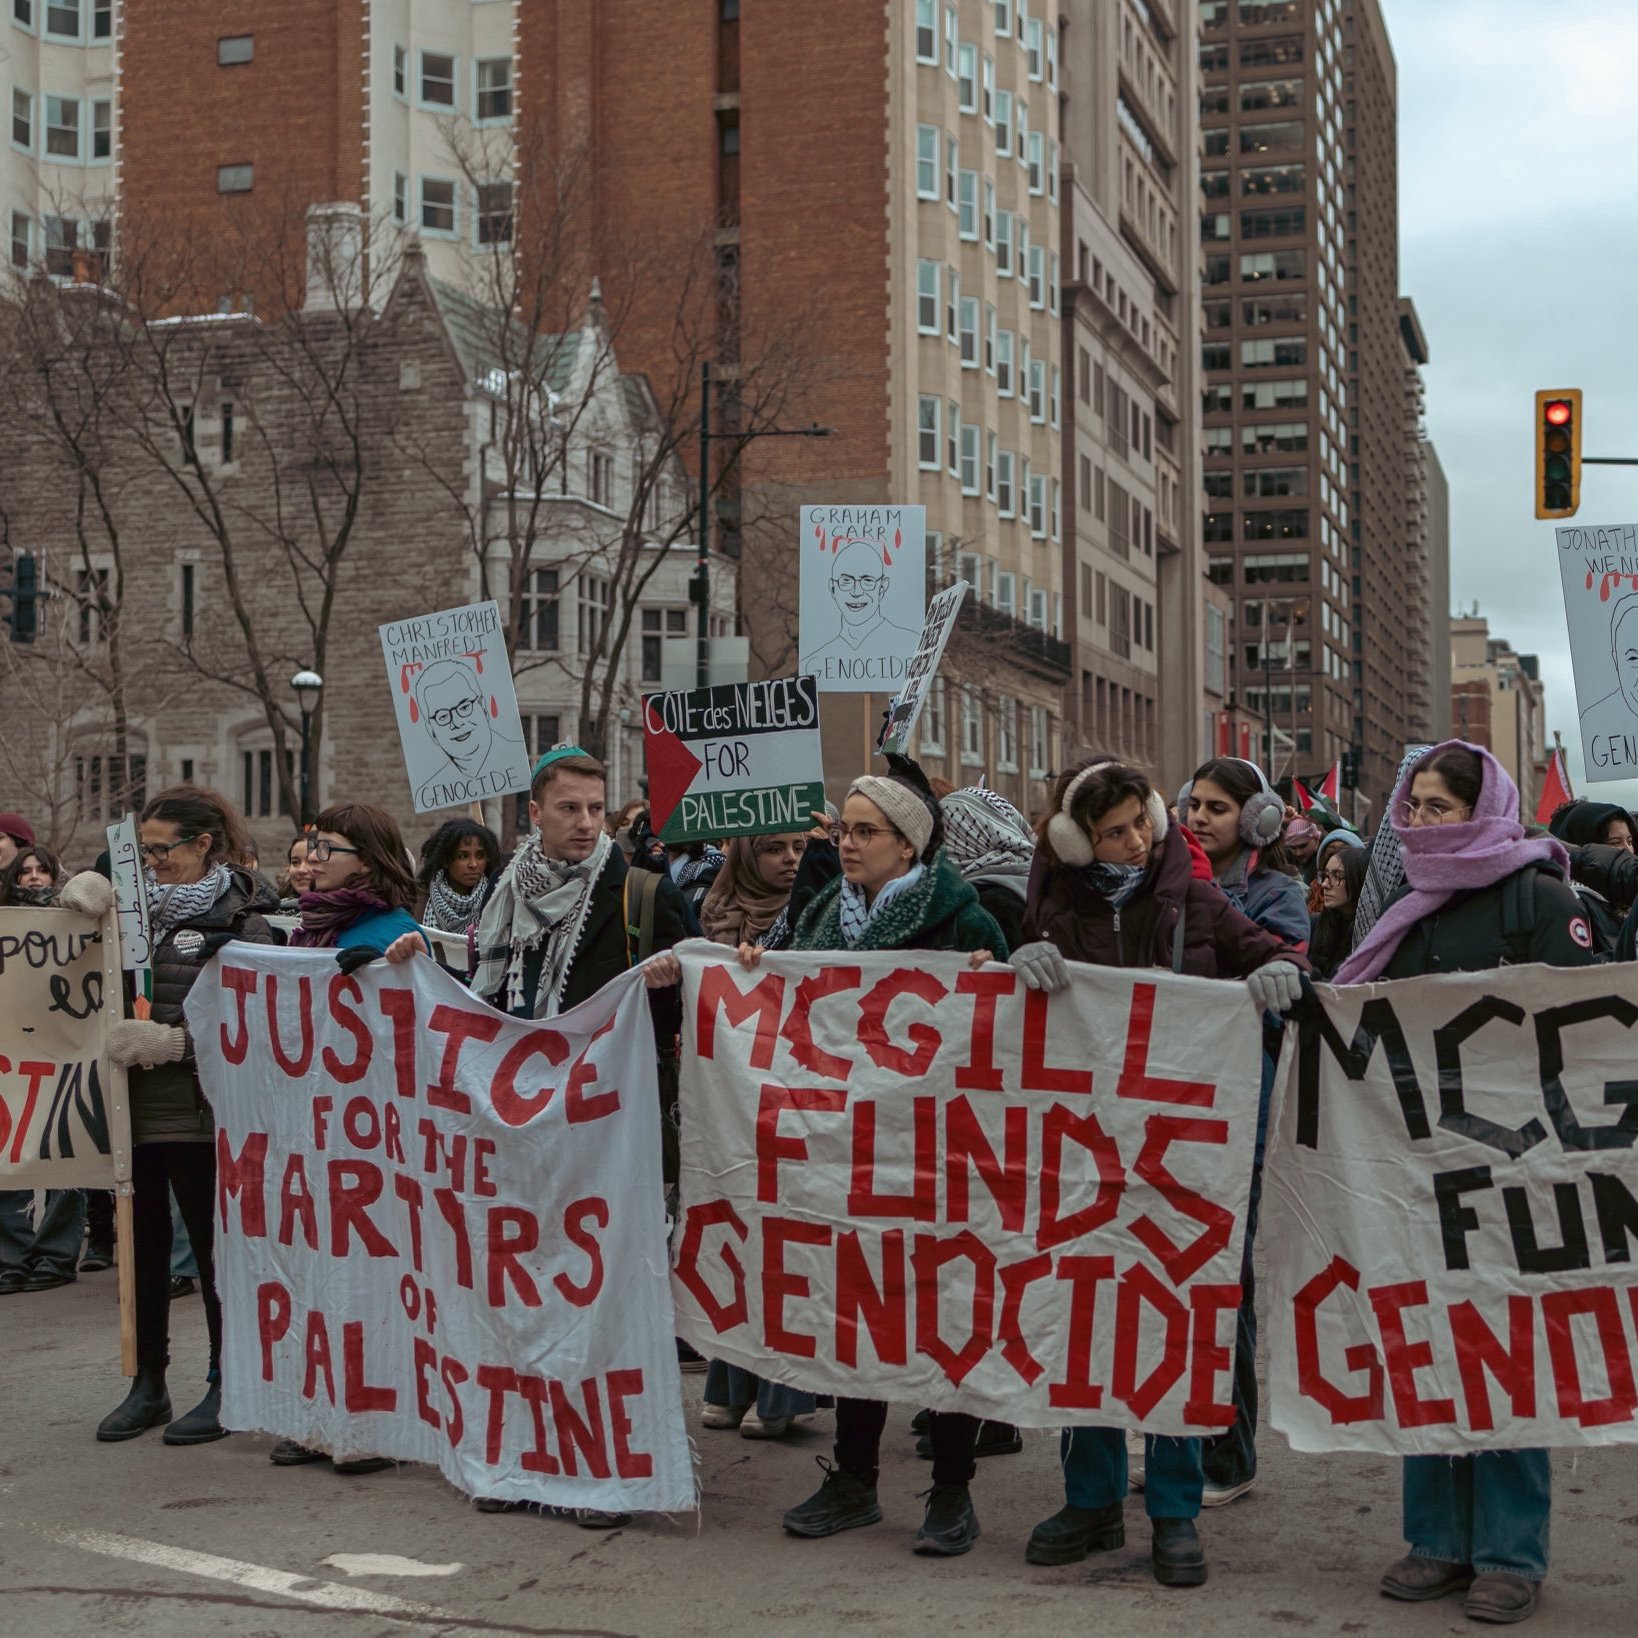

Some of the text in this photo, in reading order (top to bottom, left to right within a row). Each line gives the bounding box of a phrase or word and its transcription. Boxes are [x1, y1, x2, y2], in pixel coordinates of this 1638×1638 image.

[810, 507, 901, 525] GRAHAM
[831, 525, 888, 541] CARR
[1585, 555, 1638, 575] WEN
[386, 607, 501, 647] CHRISTOPHER
[392, 633, 486, 666] MANFREDI
[704, 741, 751, 781] FOR
[1591, 735, 1638, 768] GEN
[421, 767, 525, 809] GENOCIDE
[681, 785, 811, 832] PALESTINE
[220, 965, 622, 1128] JUSTICE
[697, 964, 1216, 1108] MCGILL
[312, 1095, 497, 1197] FOR THE
[756, 1083, 1236, 1287] FUNDS
[217, 1127, 610, 1307] MARTYRS
[400, 1273, 437, 1335] OF
[674, 1200, 1243, 1428] GENOCIDE
[1293, 1253, 1638, 1432] GENO
[256, 1281, 653, 1480] PALESTINE
